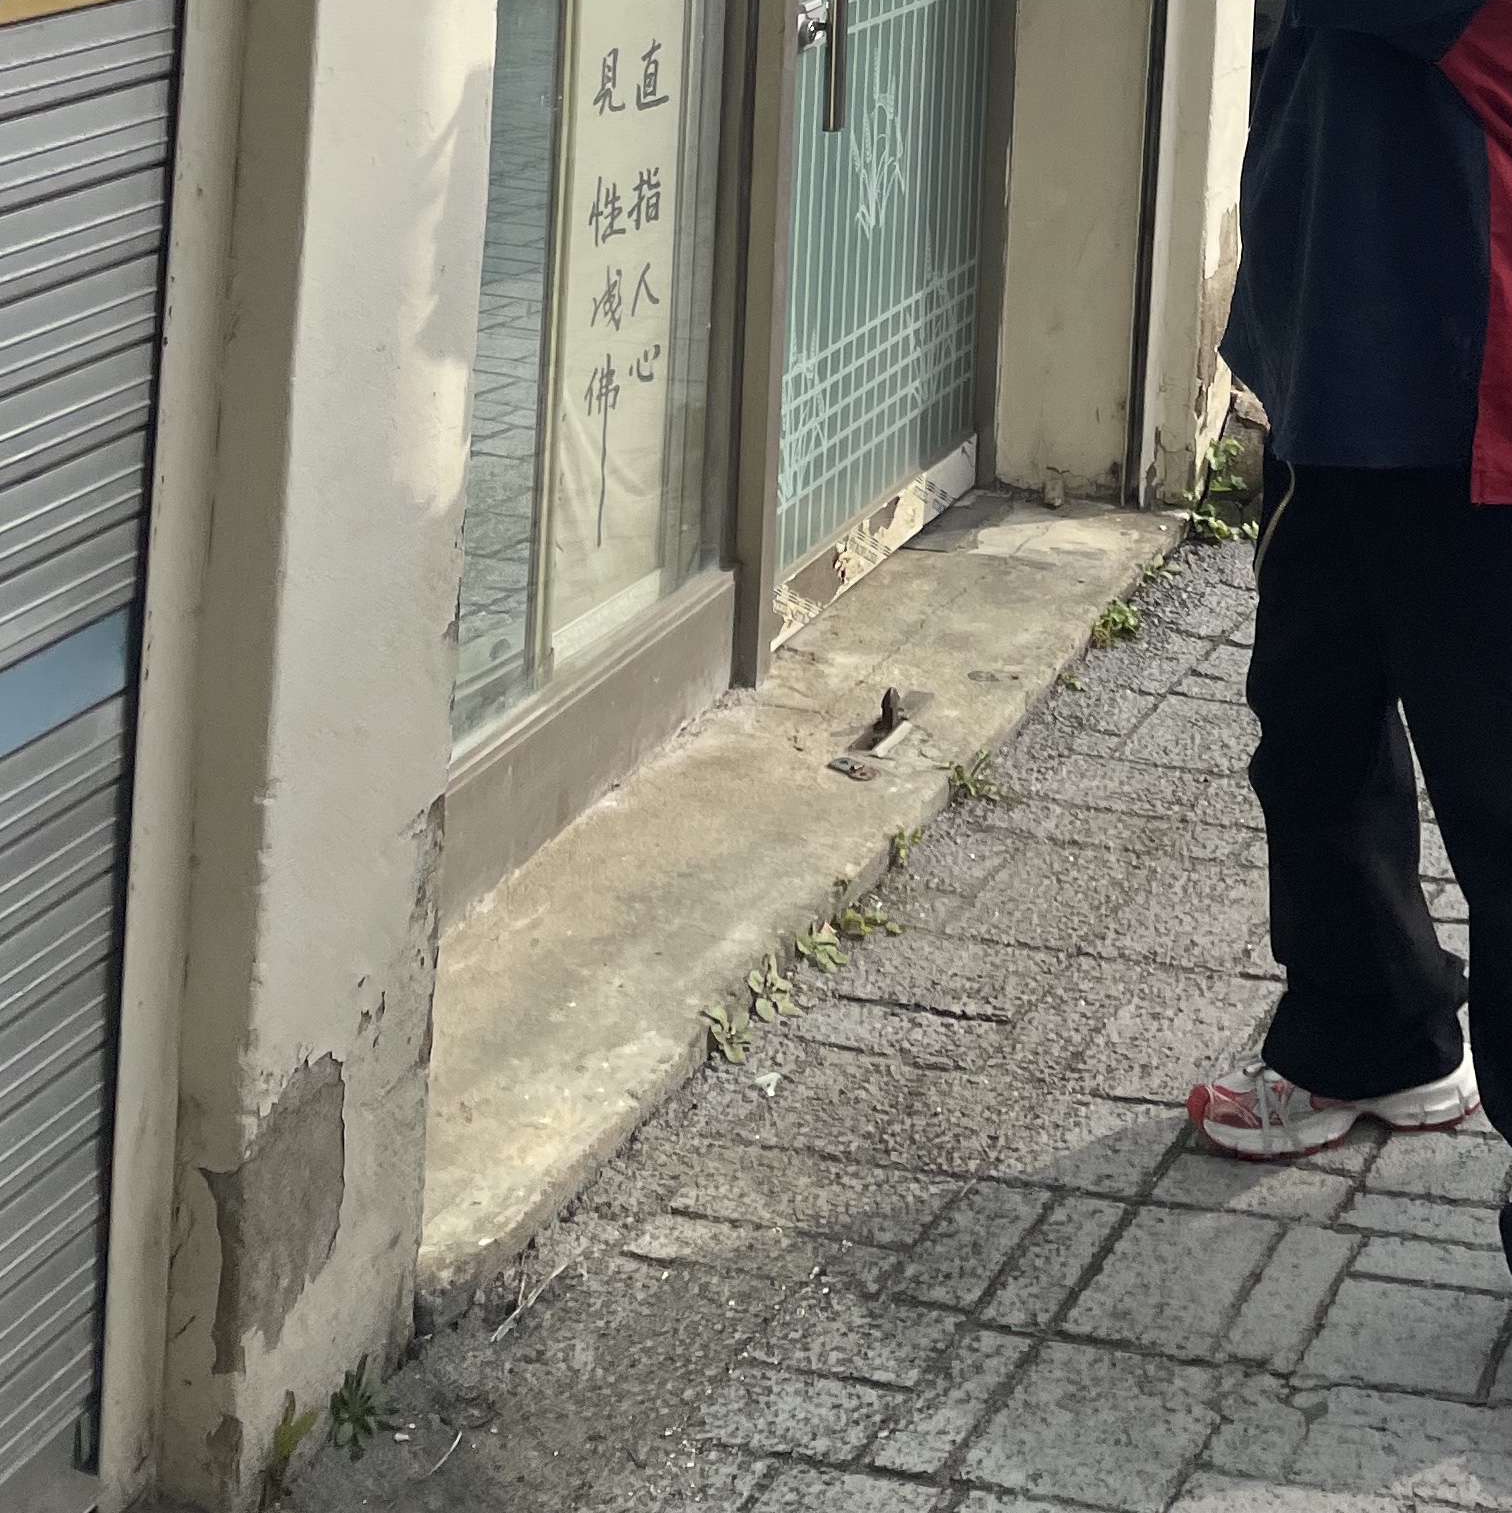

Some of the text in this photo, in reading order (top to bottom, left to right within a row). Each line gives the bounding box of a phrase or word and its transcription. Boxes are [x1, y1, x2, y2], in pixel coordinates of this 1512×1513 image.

[584, 47, 626, 547] 見性成佛
[627, 38, 670, 382] 直指人心
